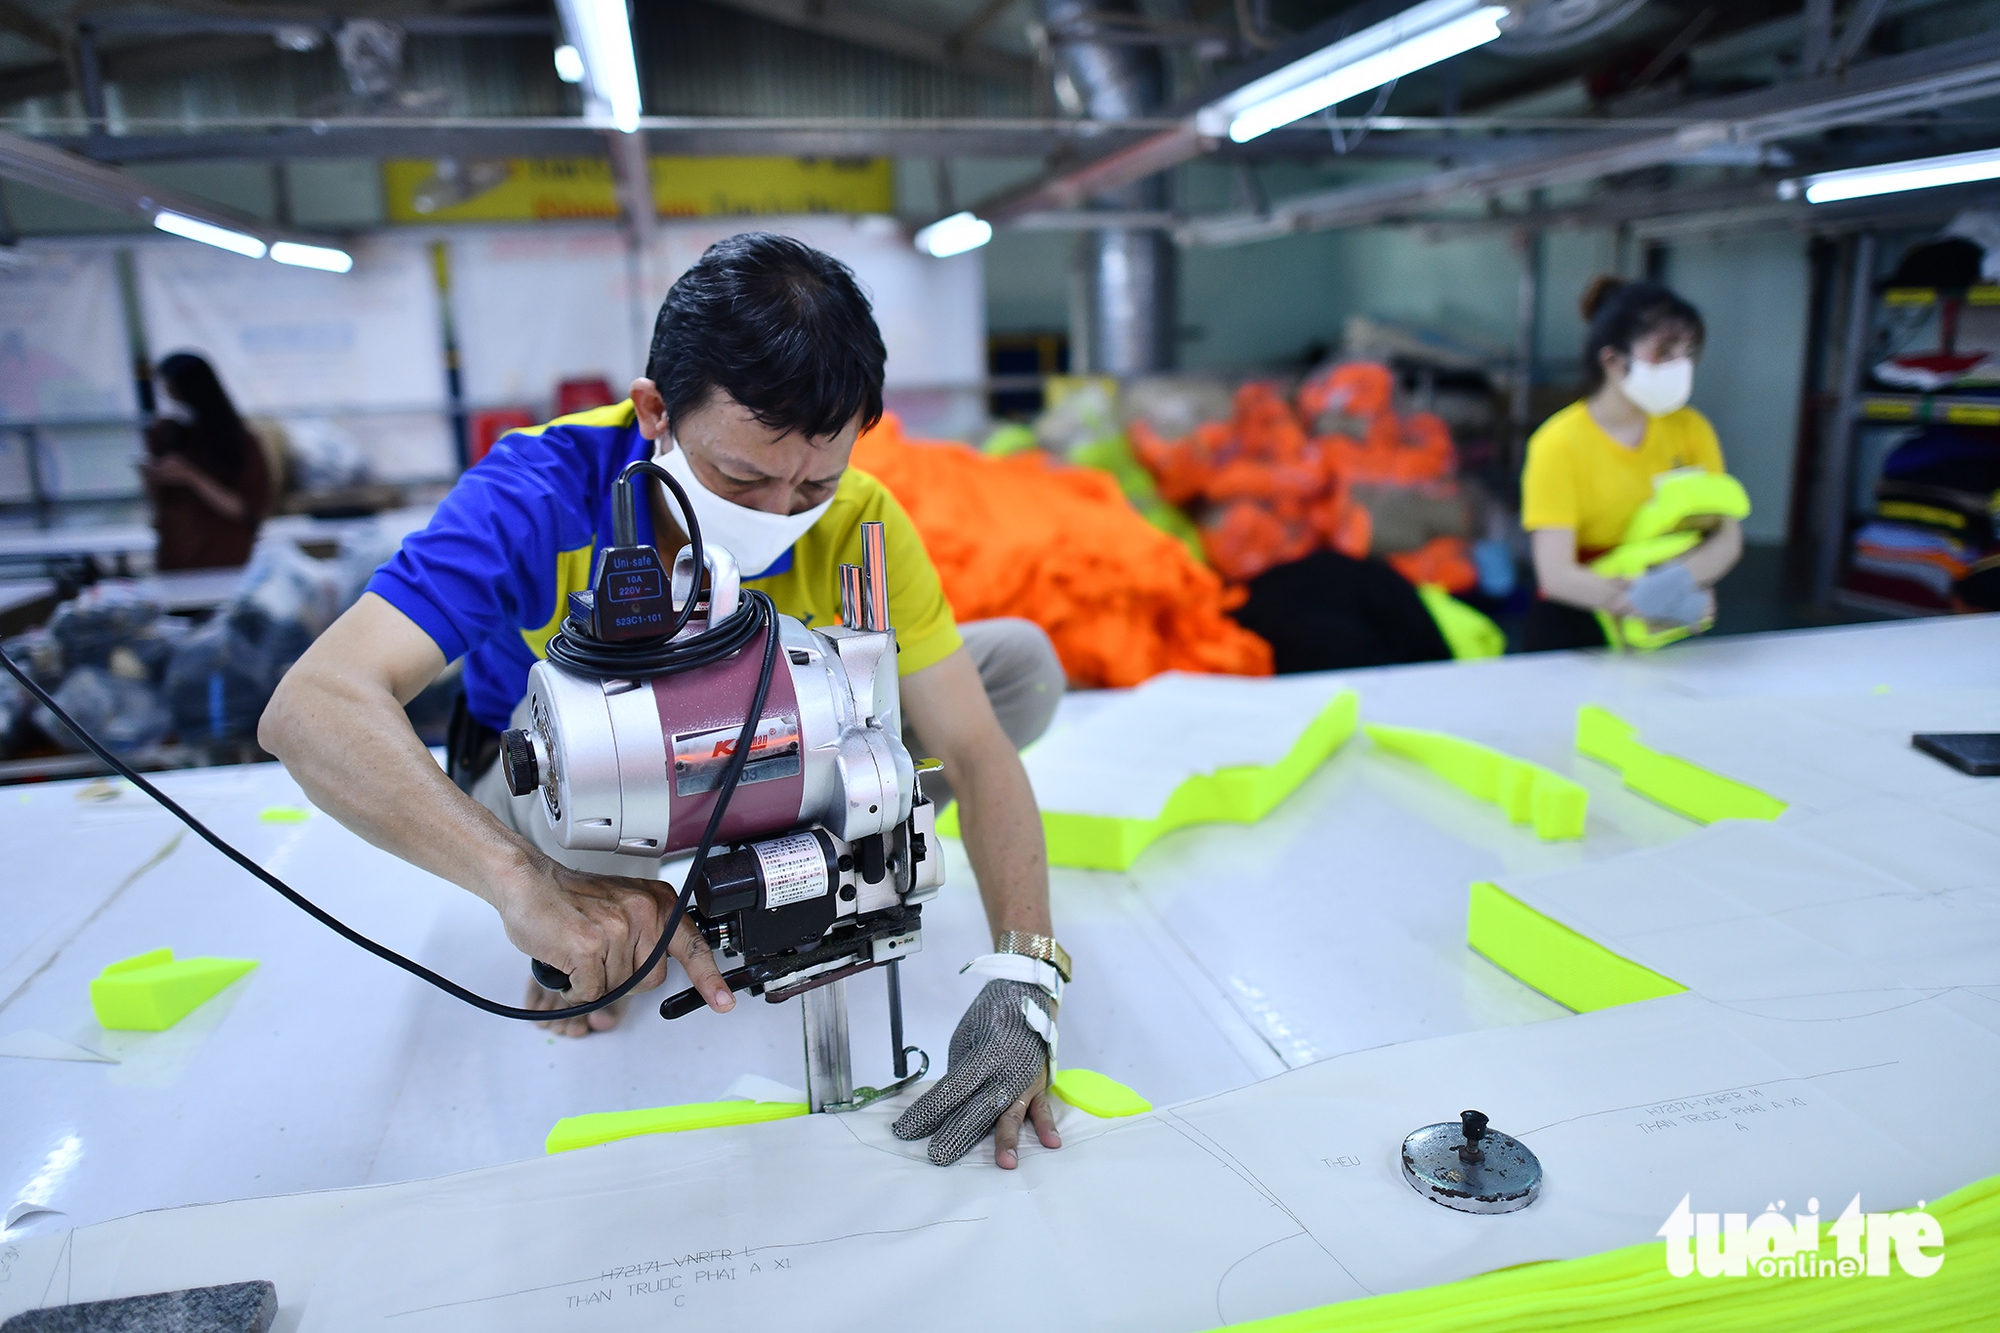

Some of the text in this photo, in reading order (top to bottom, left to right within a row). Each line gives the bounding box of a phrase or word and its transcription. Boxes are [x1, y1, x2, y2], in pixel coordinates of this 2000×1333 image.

[613, 555, 652, 569] Uni-safe
[626, 575, 643, 584] 10A
[619, 586, 641, 596] 220V
[615, 613, 662, 627] 523C1-101
[1748, 1089, 1764, 1098] M
[1636, 1119, 1678, 1135] THAN
[1729, 1103, 1767, 1116] PHAI
[1770, 1101, 1785, 1110] A
[1734, 1122, 1750, 1132] A
[1320, 1155, 1361, 1168] THEU
[744, 1245, 756, 1257] L
[566, 1288, 612, 1309] THAN
[695, 1267, 737, 1284] PHAI
[749, 1262, 762, 1275] A
[674, 1294, 686, 1308] C
